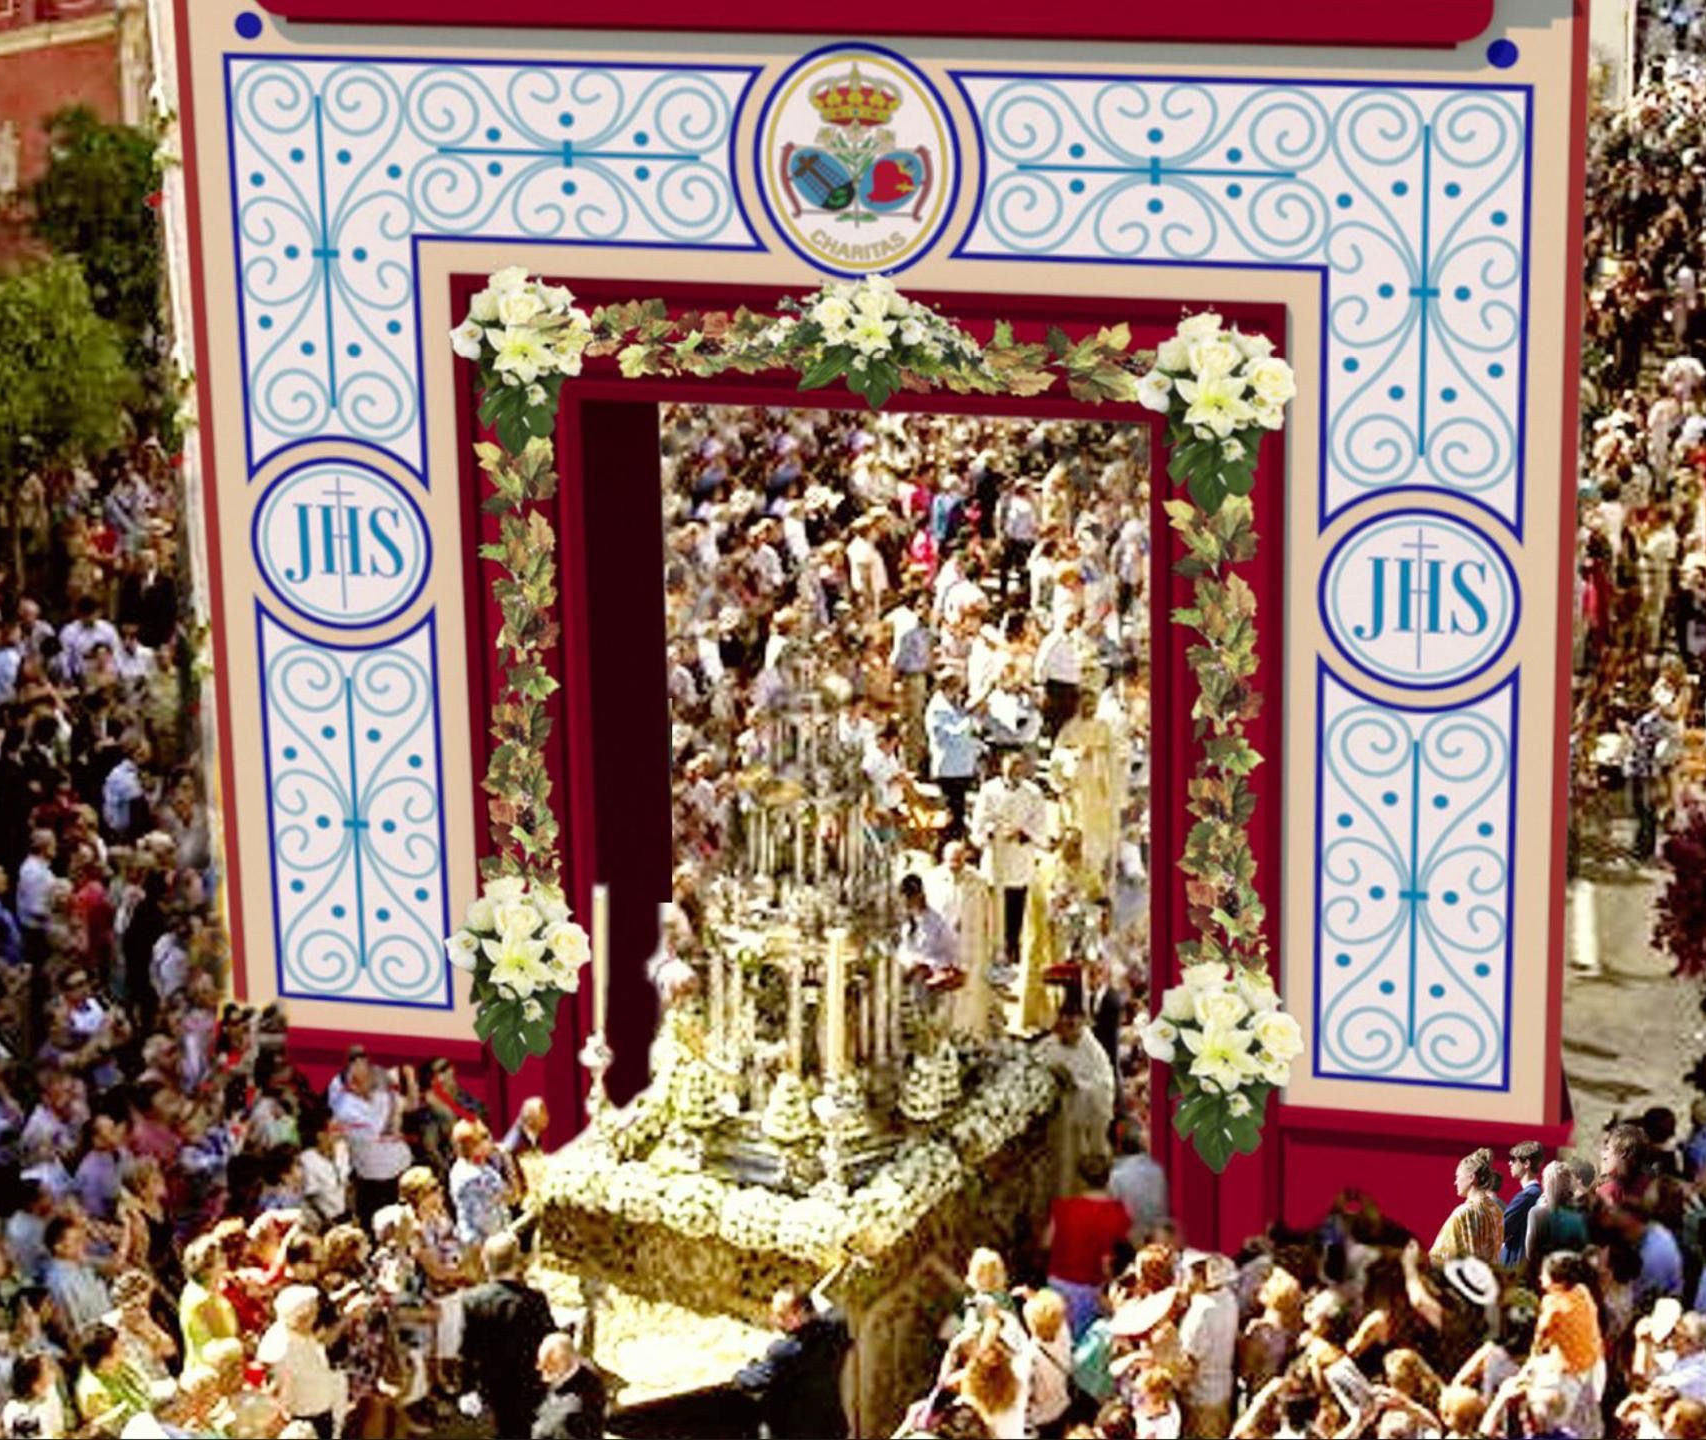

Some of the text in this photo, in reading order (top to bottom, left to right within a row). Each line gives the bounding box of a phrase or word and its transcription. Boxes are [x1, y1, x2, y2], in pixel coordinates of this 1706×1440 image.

[810, 228, 907, 260] CHARITAS
[284, 502, 405, 585] JHS
[1352, 556, 1489, 642] JHS
